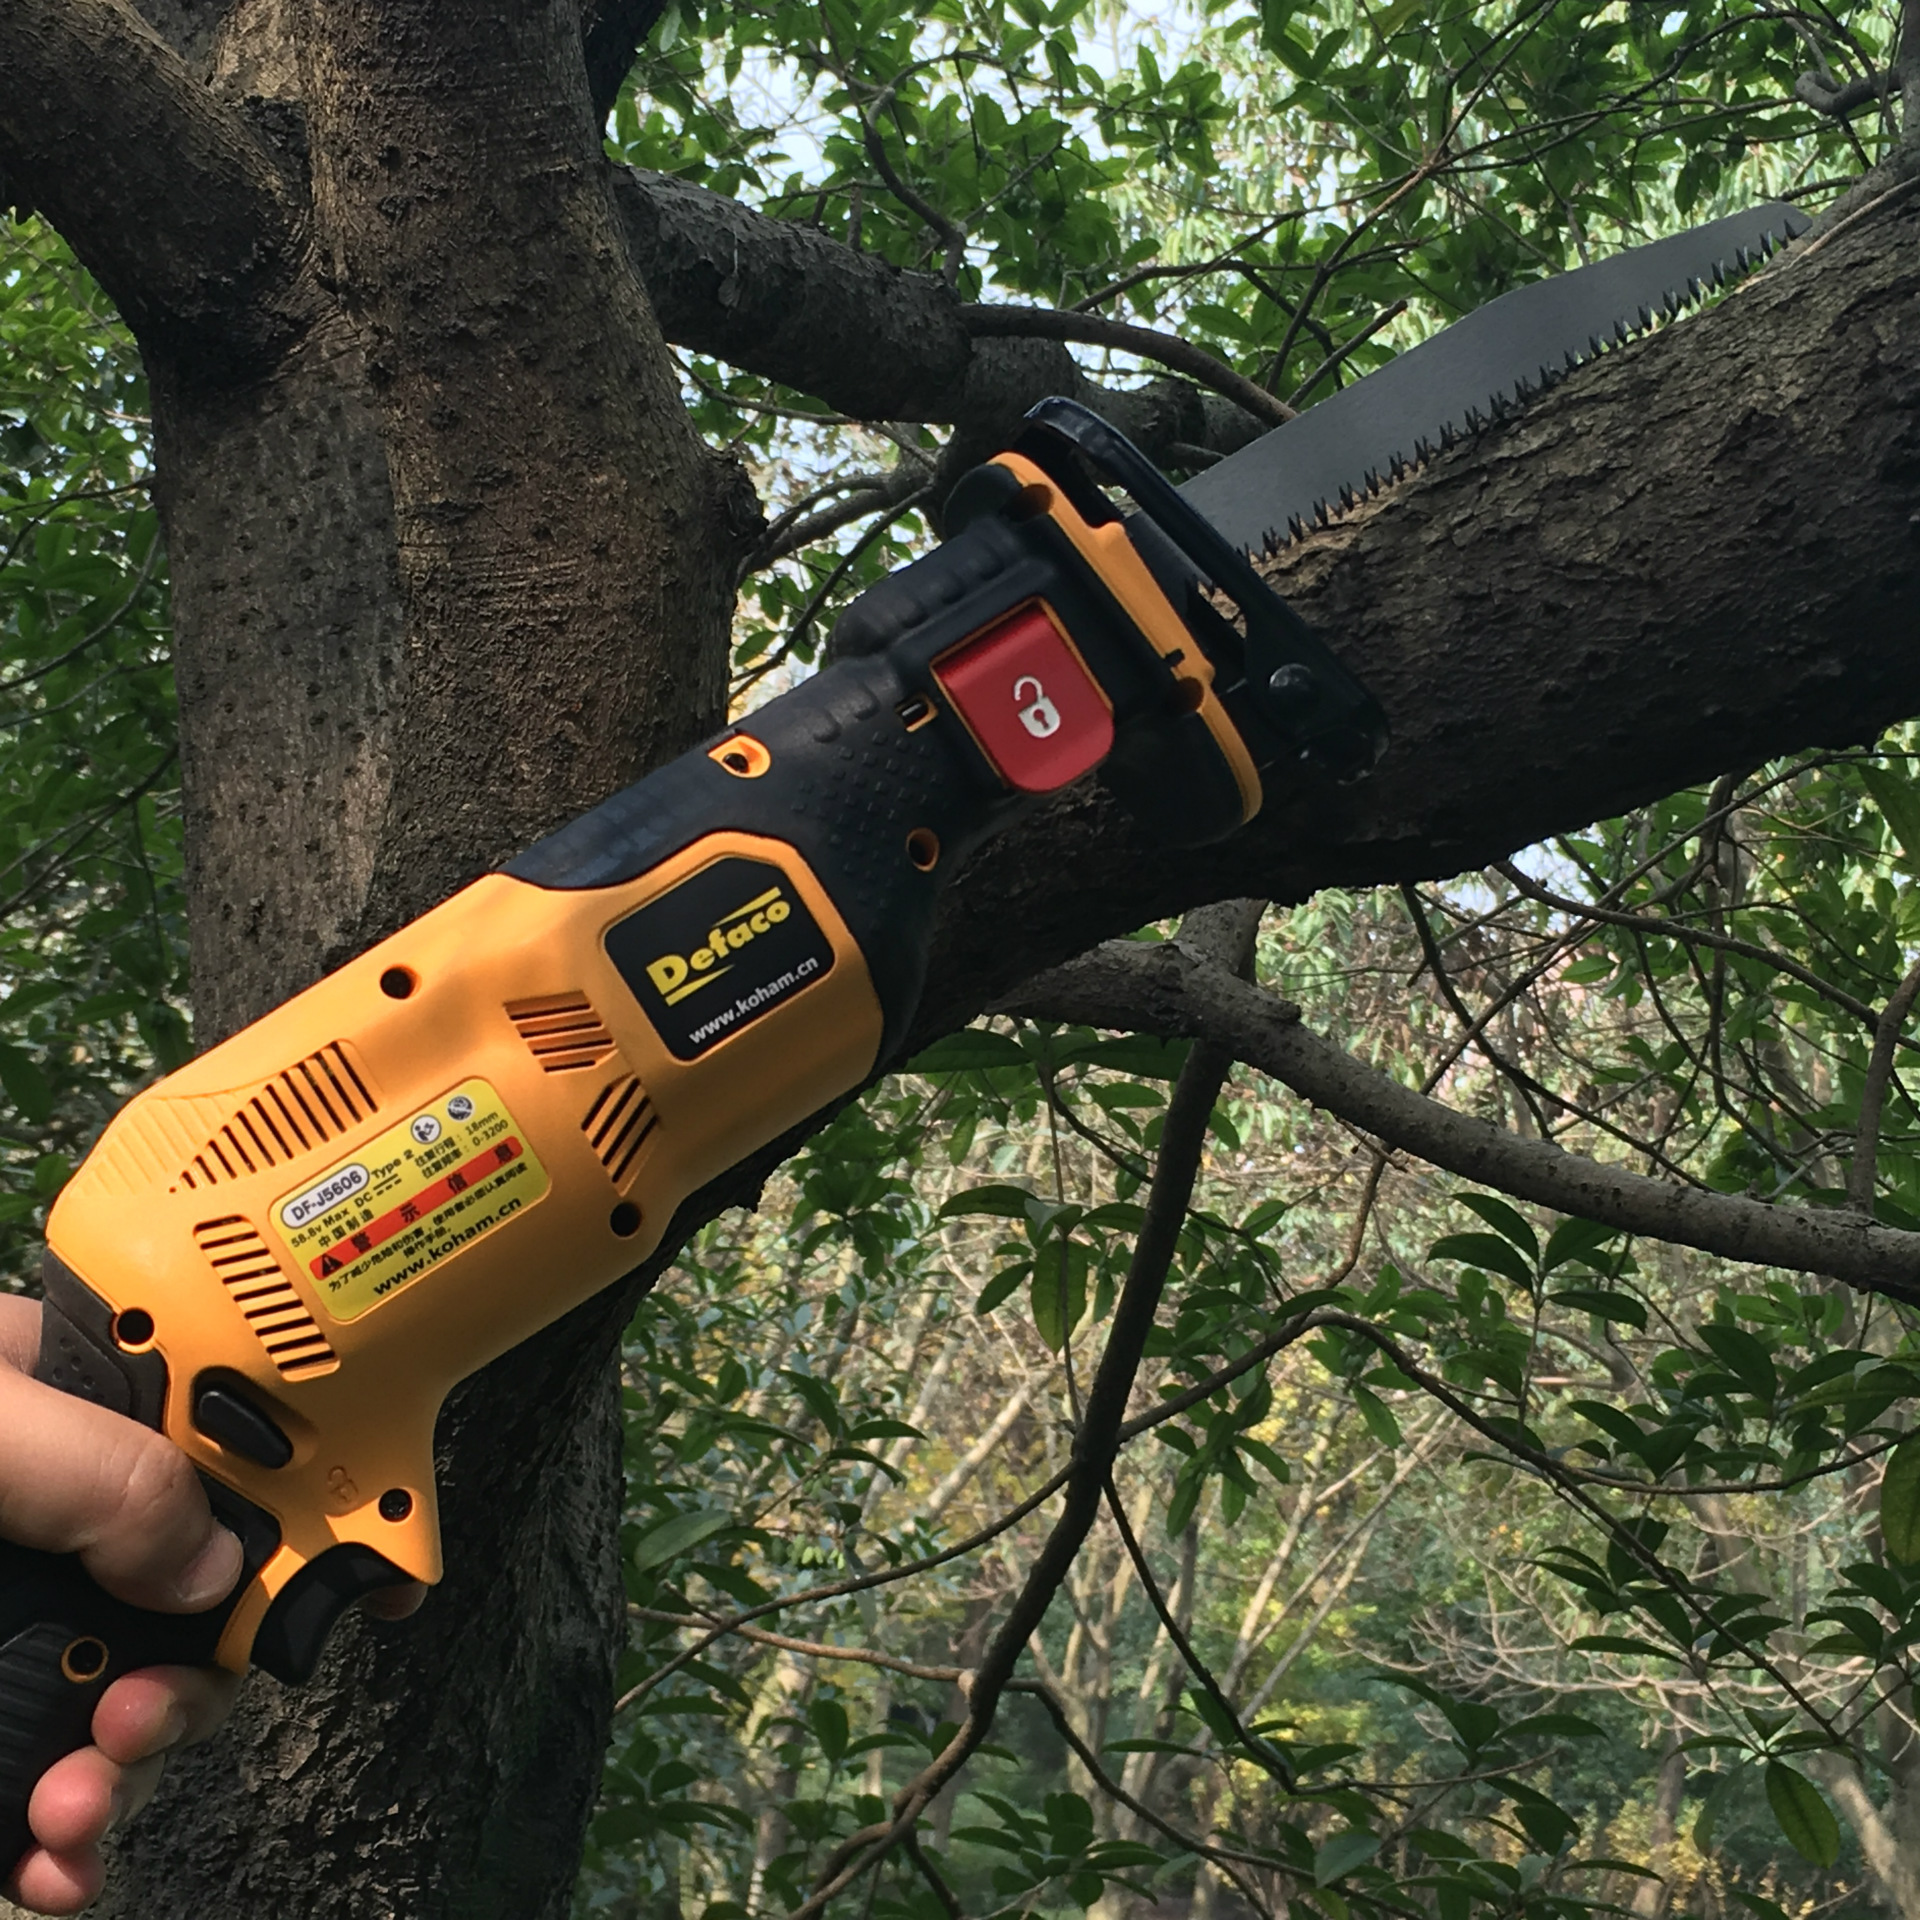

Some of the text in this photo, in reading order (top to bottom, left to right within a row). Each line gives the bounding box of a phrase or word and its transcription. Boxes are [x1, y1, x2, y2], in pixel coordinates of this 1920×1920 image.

[646, 900, 791, 996] Defaco
[688, 956, 819, 1044] www.koham.cn
[465, 1112, 499, 1136] 18mm
[472, 1119, 509, 1147] 0-3200
[370, 1148, 415, 1181] Type 2
[290, 1170, 363, 1222] DF-J5606
[322, 1208, 350, 1228] Max
[354, 1191, 374, 1208] DC
[372, 1197, 522, 1297] www.koham.cn
